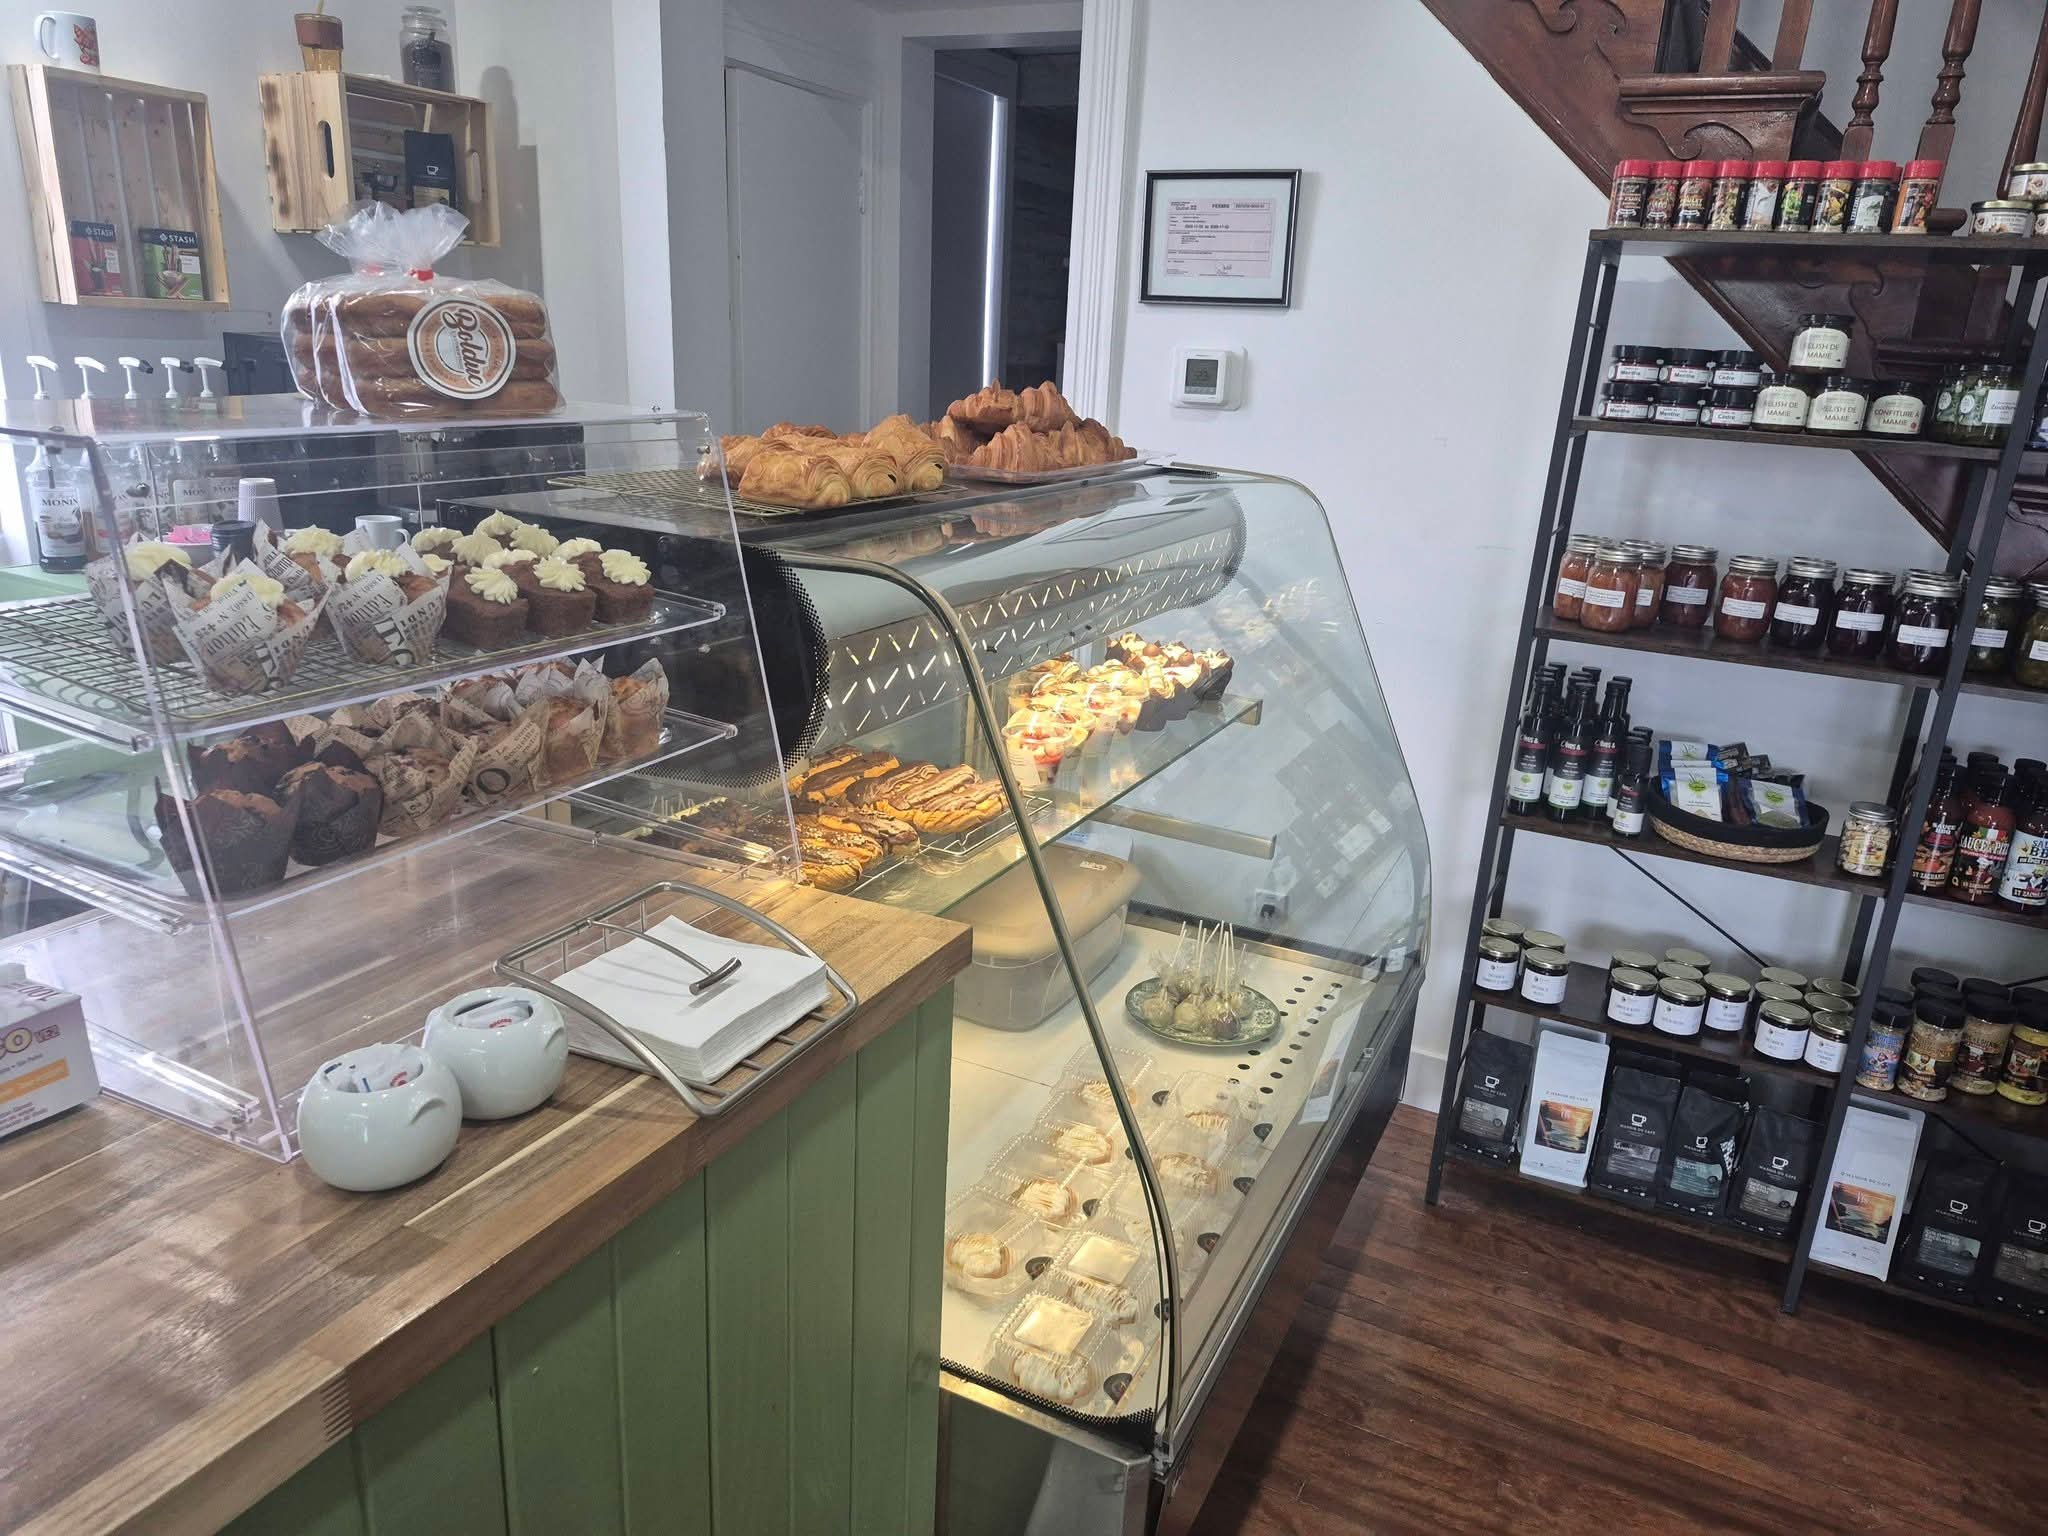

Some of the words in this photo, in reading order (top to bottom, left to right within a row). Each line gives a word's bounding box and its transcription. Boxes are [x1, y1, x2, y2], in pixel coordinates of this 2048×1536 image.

[93, 228, 114, 237] STASH
[168, 234, 195, 244] STASH
[442, 308, 486, 387] Bolduc
[1803, 342, 1829, 351] ELISH
[1829, 343, 1840, 351] DE
[1807, 352, 1833, 360] MAMIE
[1788, 401, 1799, 409] DE
[1847, 406, 1857, 414] DE
[1875, 408, 1914, 418] CONFITURE
[183, 489, 206, 497] MON
[41, 497, 79, 507] MONIN
[206, 614, 262, 657] Edition
[1960, 835, 1988, 852] SAUCE
